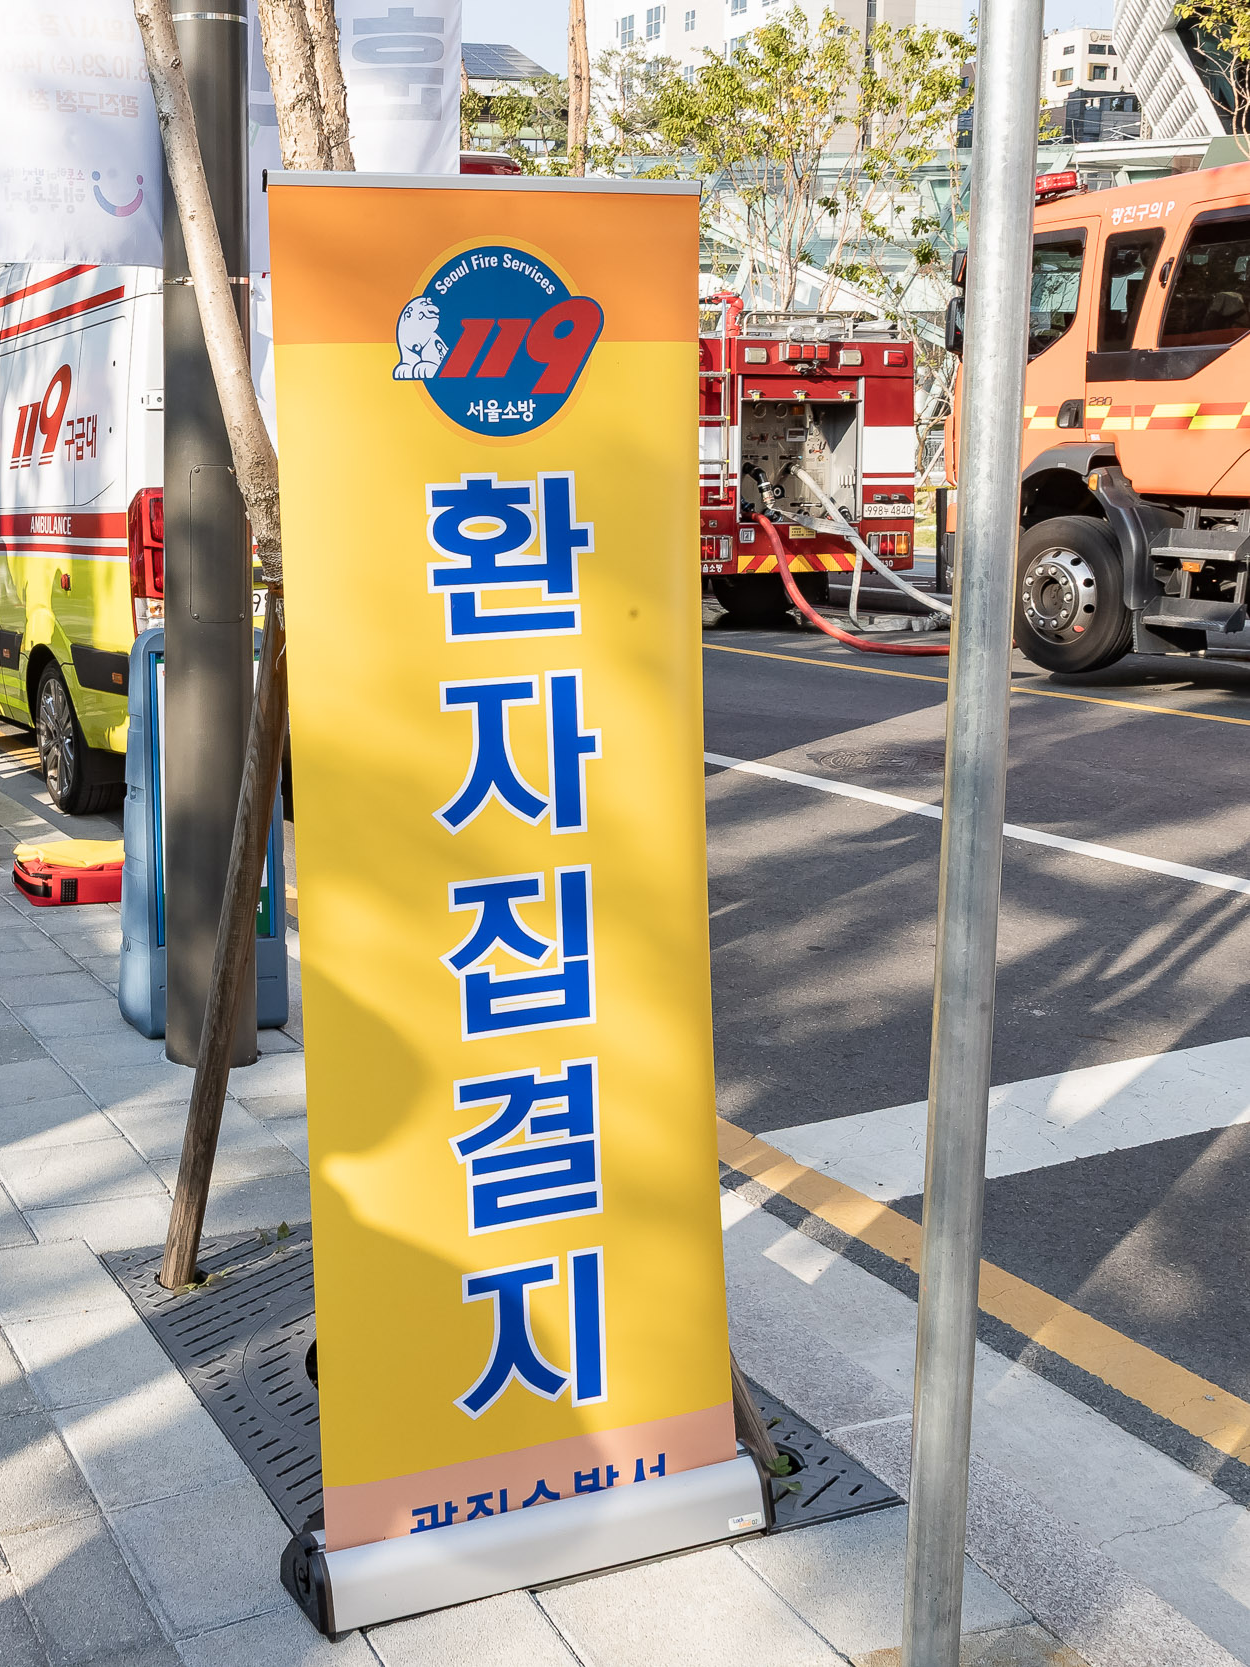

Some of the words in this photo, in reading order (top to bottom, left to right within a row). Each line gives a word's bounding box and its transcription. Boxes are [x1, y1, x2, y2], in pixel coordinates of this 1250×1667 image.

[1111, 202, 1164, 226] 광진구의
[1165, 200, 1176, 217] P
[434, 260, 470, 295] Seoul
[471, 253, 499, 271] Fire
[502, 253, 556, 296] Services
[438, 298, 601, 394] 119
[466, 399, 536, 423] 서울소방
[30, 516, 72, 535] AMBULANCE
[702, 563, 724, 573] 울소방
